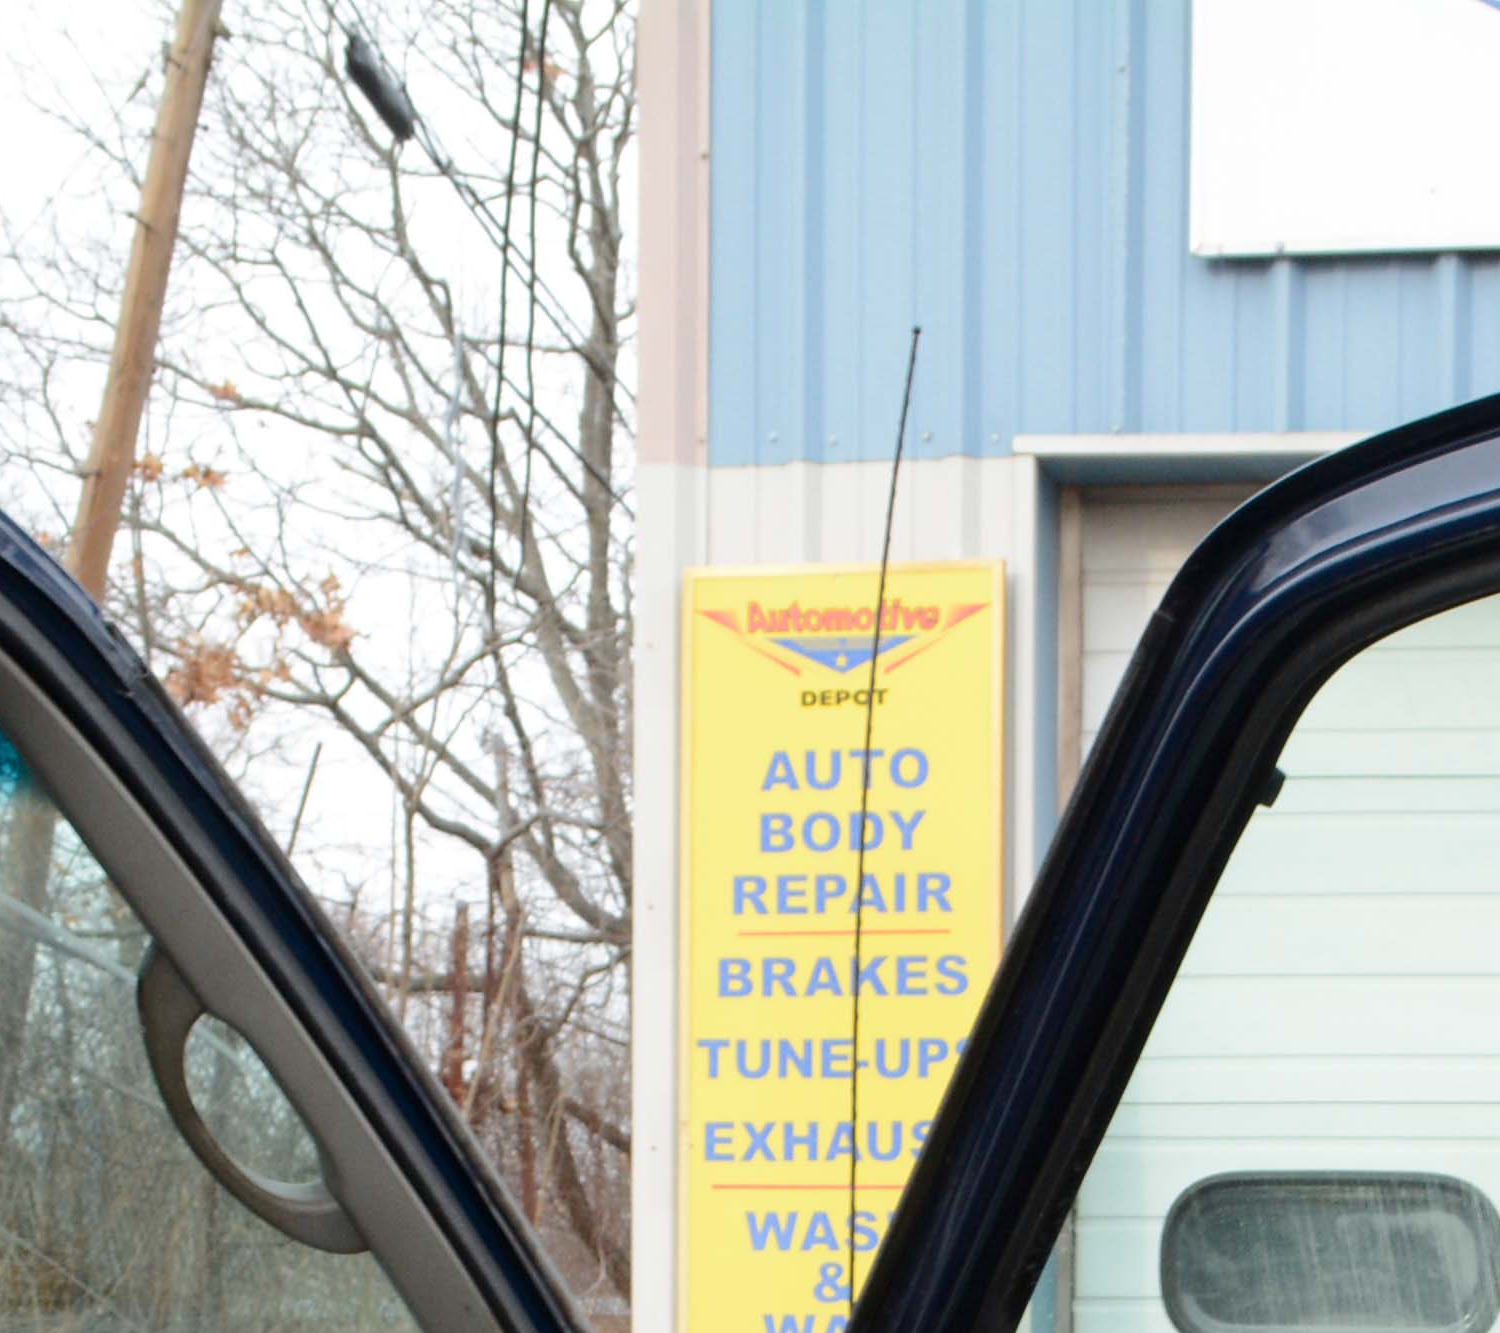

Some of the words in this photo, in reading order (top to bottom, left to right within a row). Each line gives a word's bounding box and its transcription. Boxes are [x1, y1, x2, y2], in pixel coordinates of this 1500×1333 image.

[747, 597, 941, 633] Automotive
[800, 687, 888, 708] DEPOT
[760, 747, 930, 791] AUTO
[759, 809, 927, 854] BODY
[731, 872, 953, 915] REPAIR
[716, 954, 970, 998] BRAKES
[696, 1036, 970, 1080] TUNE-UP
[703, 1119, 936, 1163] EXHAUS
[745, 1209, 900, 1253] WAS
[813, 1261, 853, 1304] &
